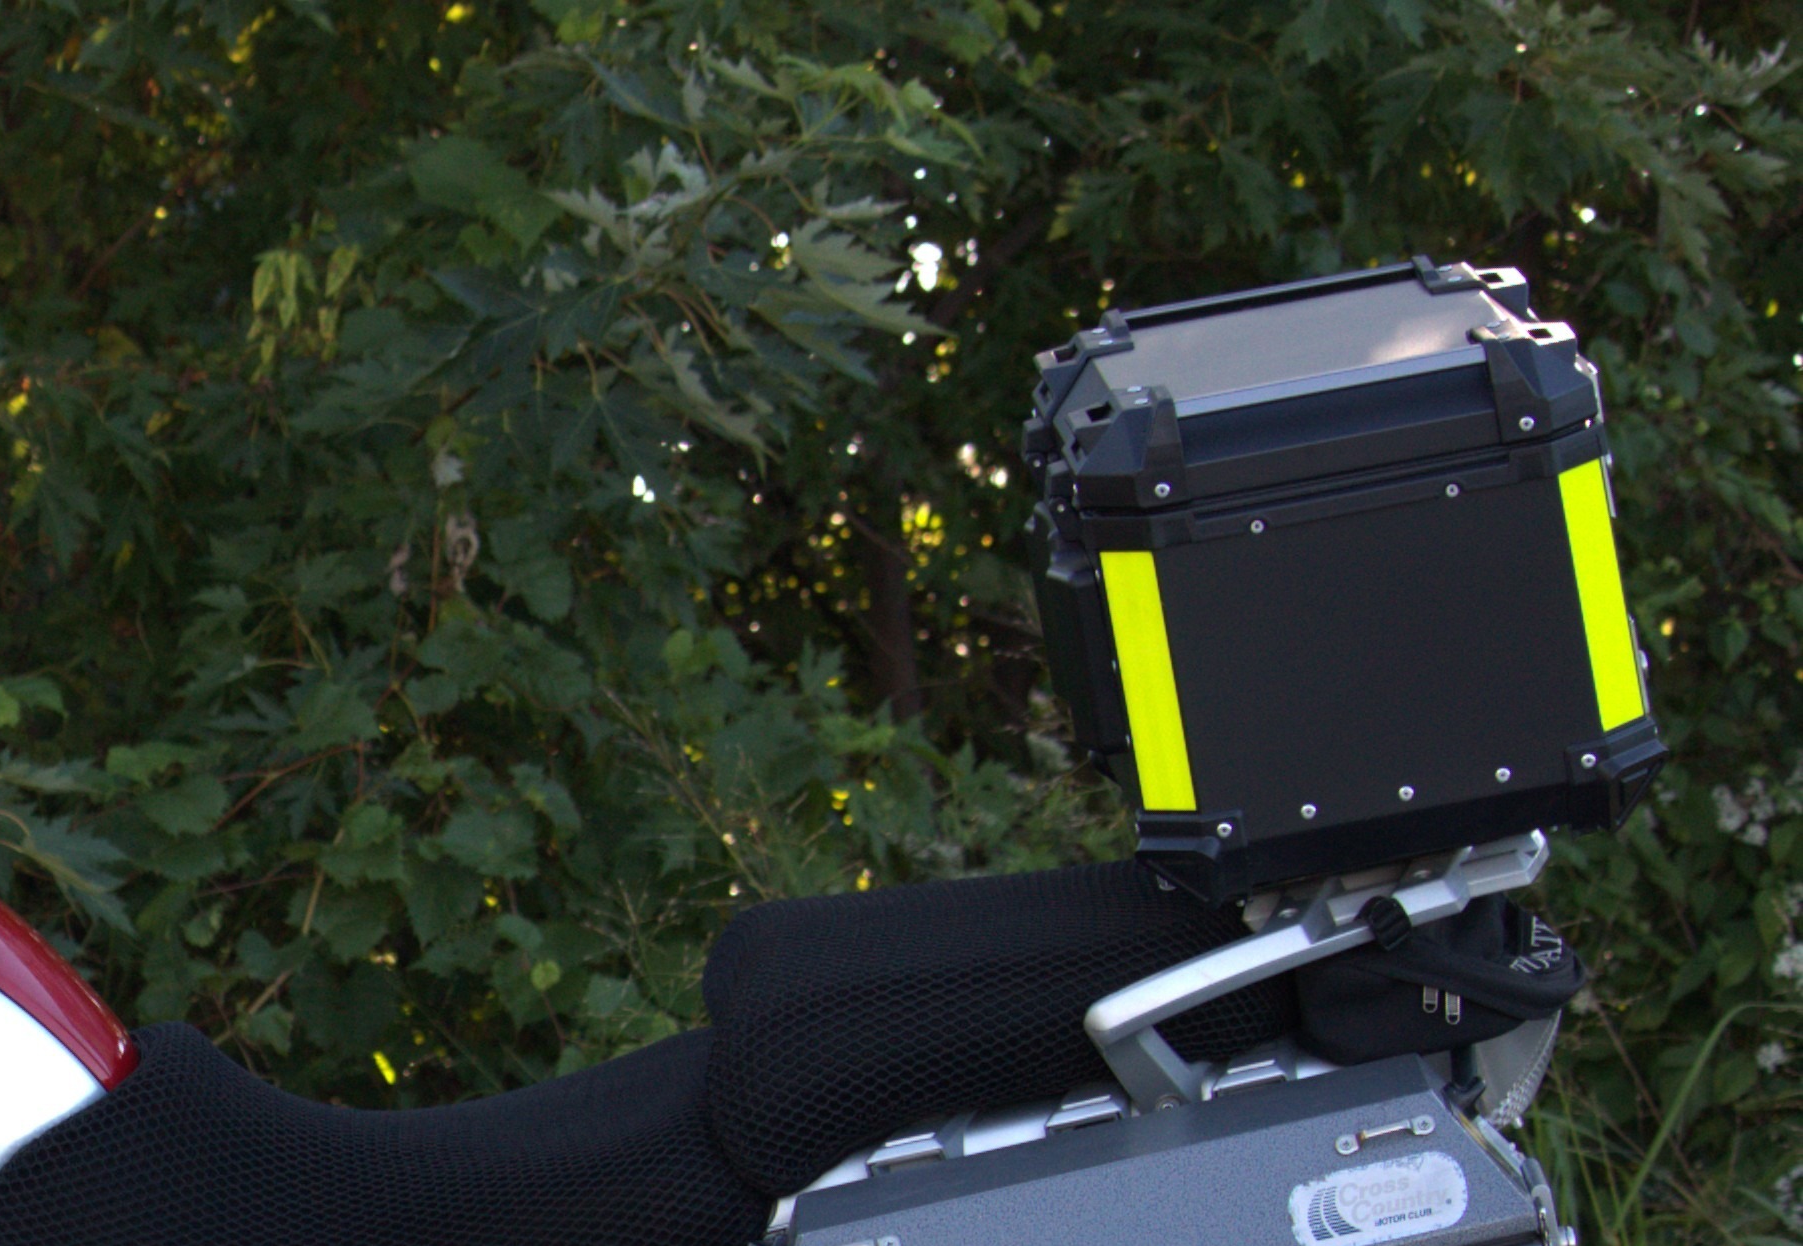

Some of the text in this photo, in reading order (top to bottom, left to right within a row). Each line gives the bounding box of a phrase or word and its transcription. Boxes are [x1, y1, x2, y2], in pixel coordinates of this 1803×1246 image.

[1339, 1177, 1410, 1207] Cross
[1351, 1187, 1448, 1224] Country
[1408, 1207, 1432, 1220] CLUB
